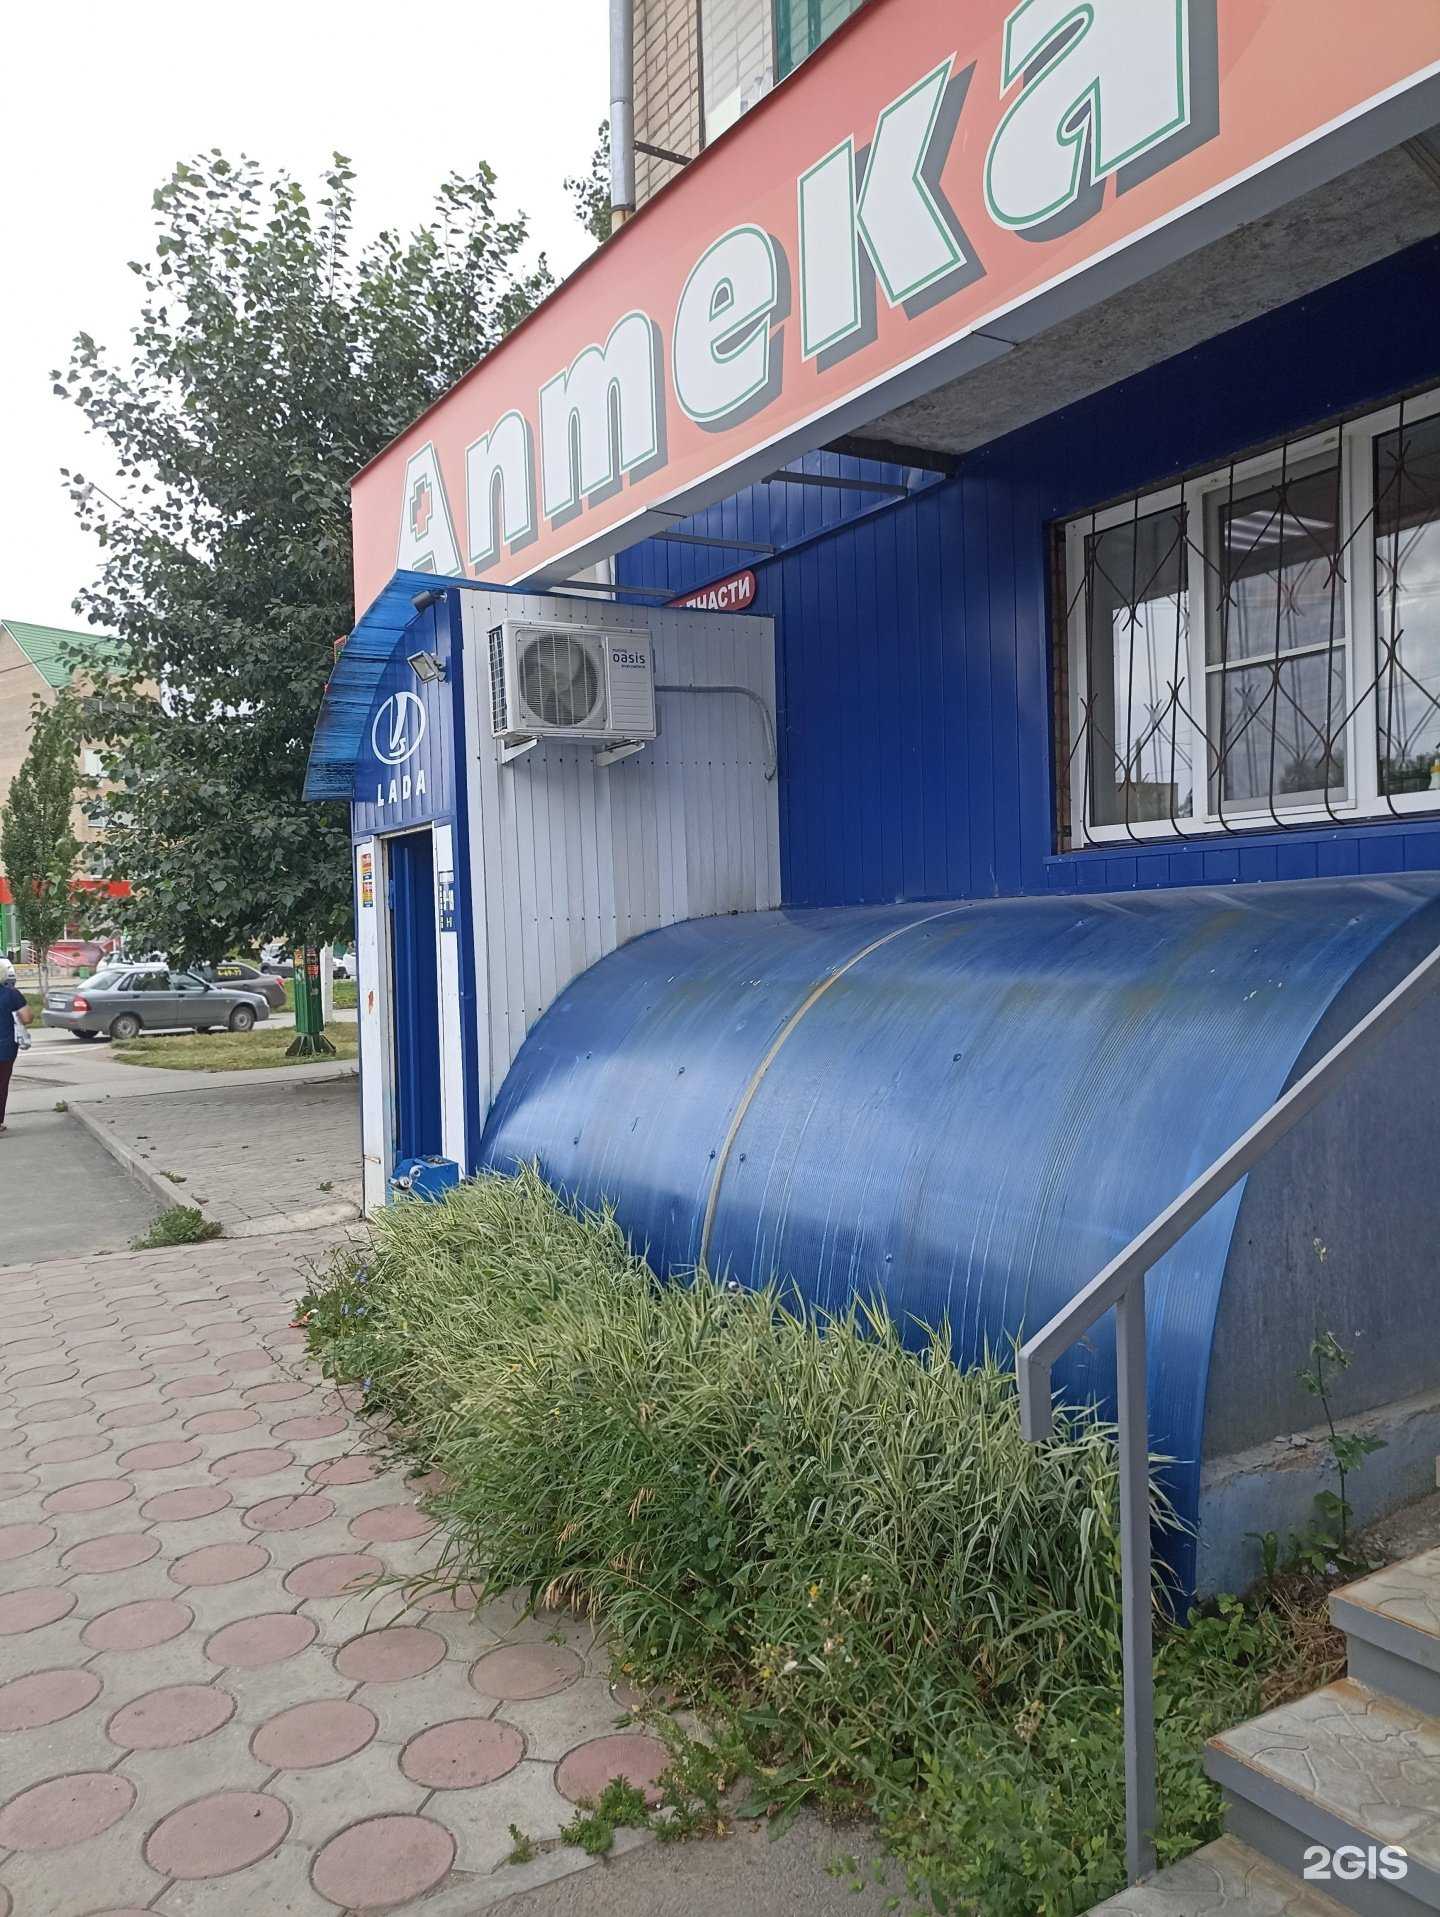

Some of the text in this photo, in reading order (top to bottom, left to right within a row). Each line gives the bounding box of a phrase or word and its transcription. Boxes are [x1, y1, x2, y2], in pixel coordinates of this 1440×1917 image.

[396, 0, 1191, 577] Аптека
[612, 651, 646, 664] oasis
[377, 769, 426, 807] LADA
